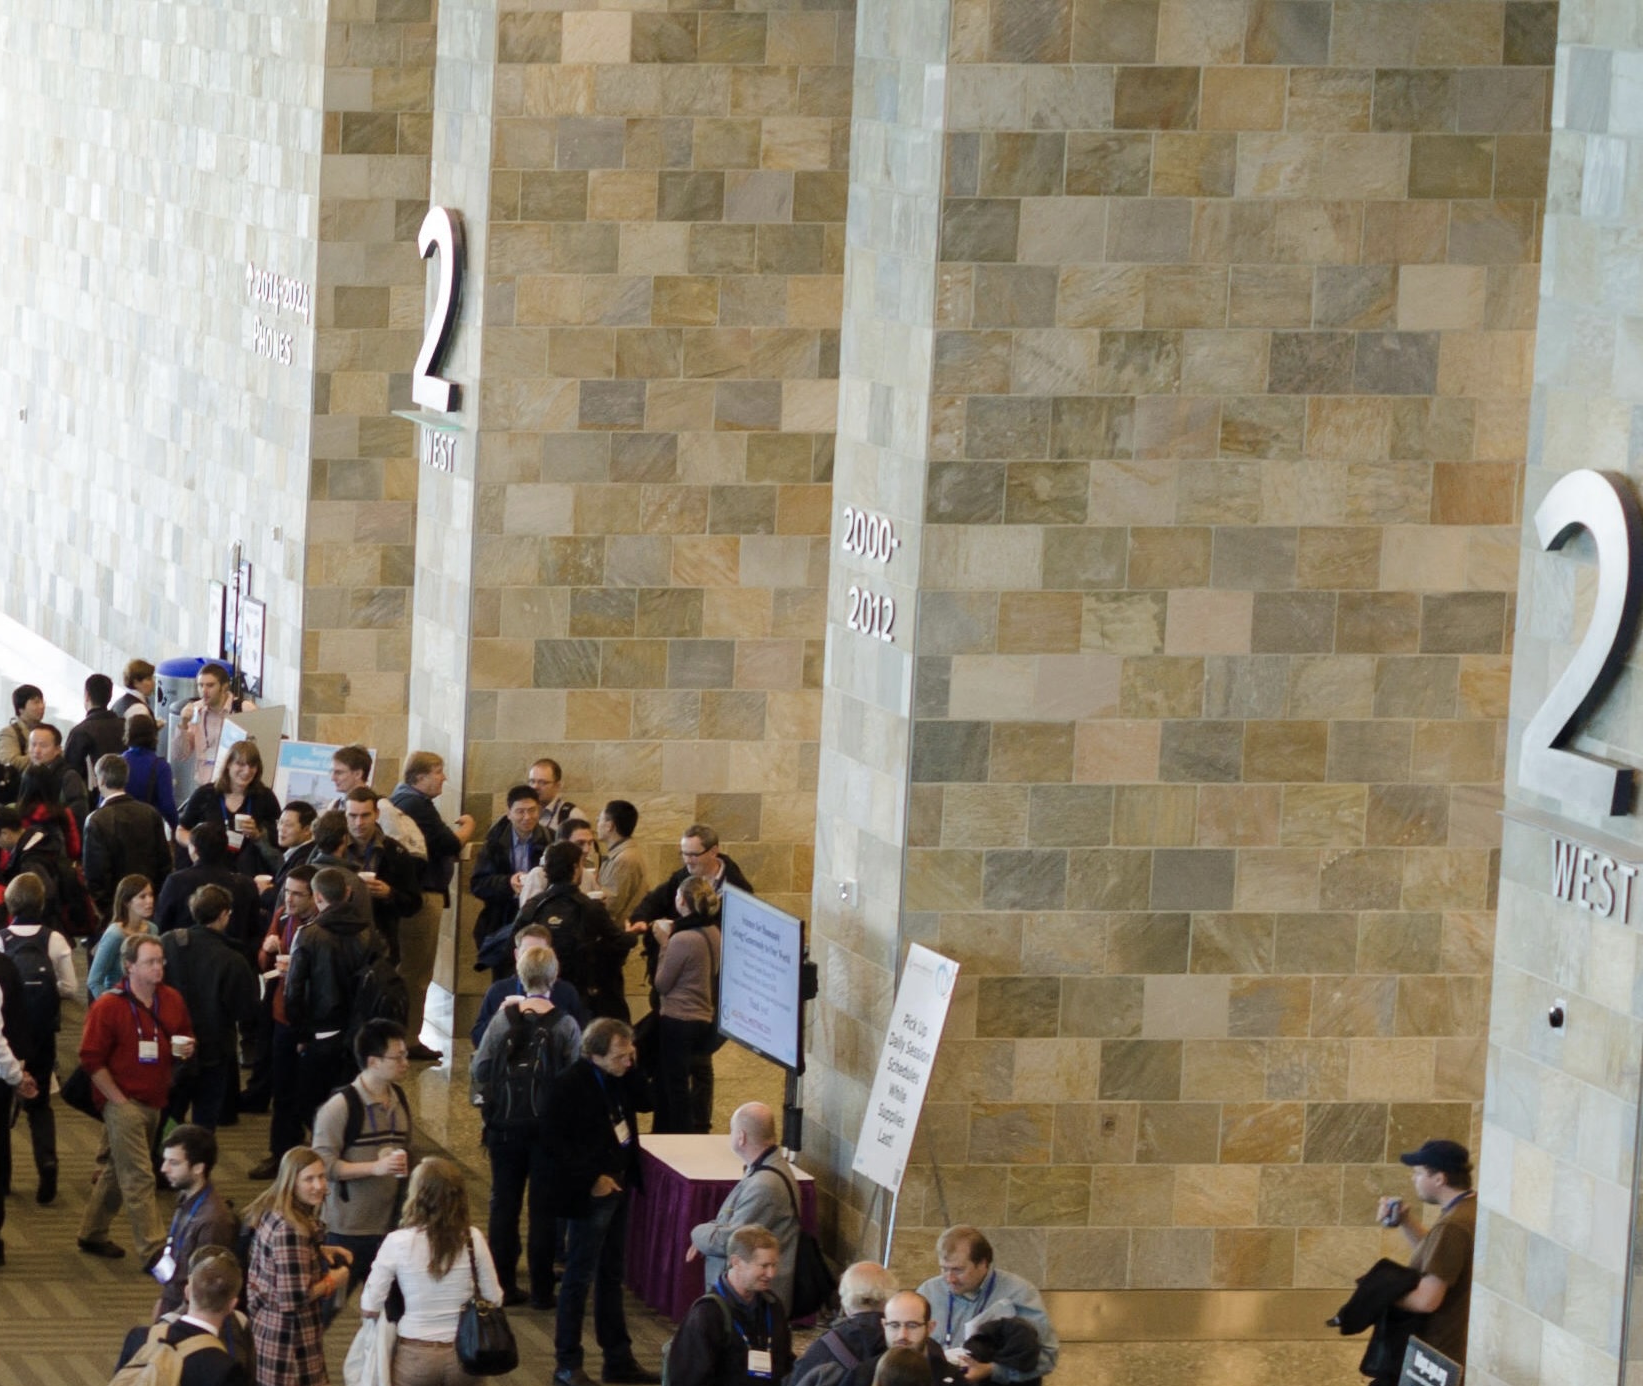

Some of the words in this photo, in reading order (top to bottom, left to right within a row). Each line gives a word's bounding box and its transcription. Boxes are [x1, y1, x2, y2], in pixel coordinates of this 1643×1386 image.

[255, 270, 311, 325] 2014-2024
[412, 206, 460, 412] 2
[423, 428, 456, 473] WEST
[842, 507, 899, 563] 2000-
[848, 586, 895, 643] 2012
[1518, 469, 1637, 816] 2
[1551, 838, 1638, 925] WEST
[888, 1031, 906, 1054] Daily
[905, 1040, 931, 1065] Session
[903, 1013, 918, 1032] Pick
[918, 1020, 928, 1038] Up
[886, 1056, 920, 1086] Schedules
[888, 1081, 908, 1104] While
[877, 1102, 906, 1130] Supplies
